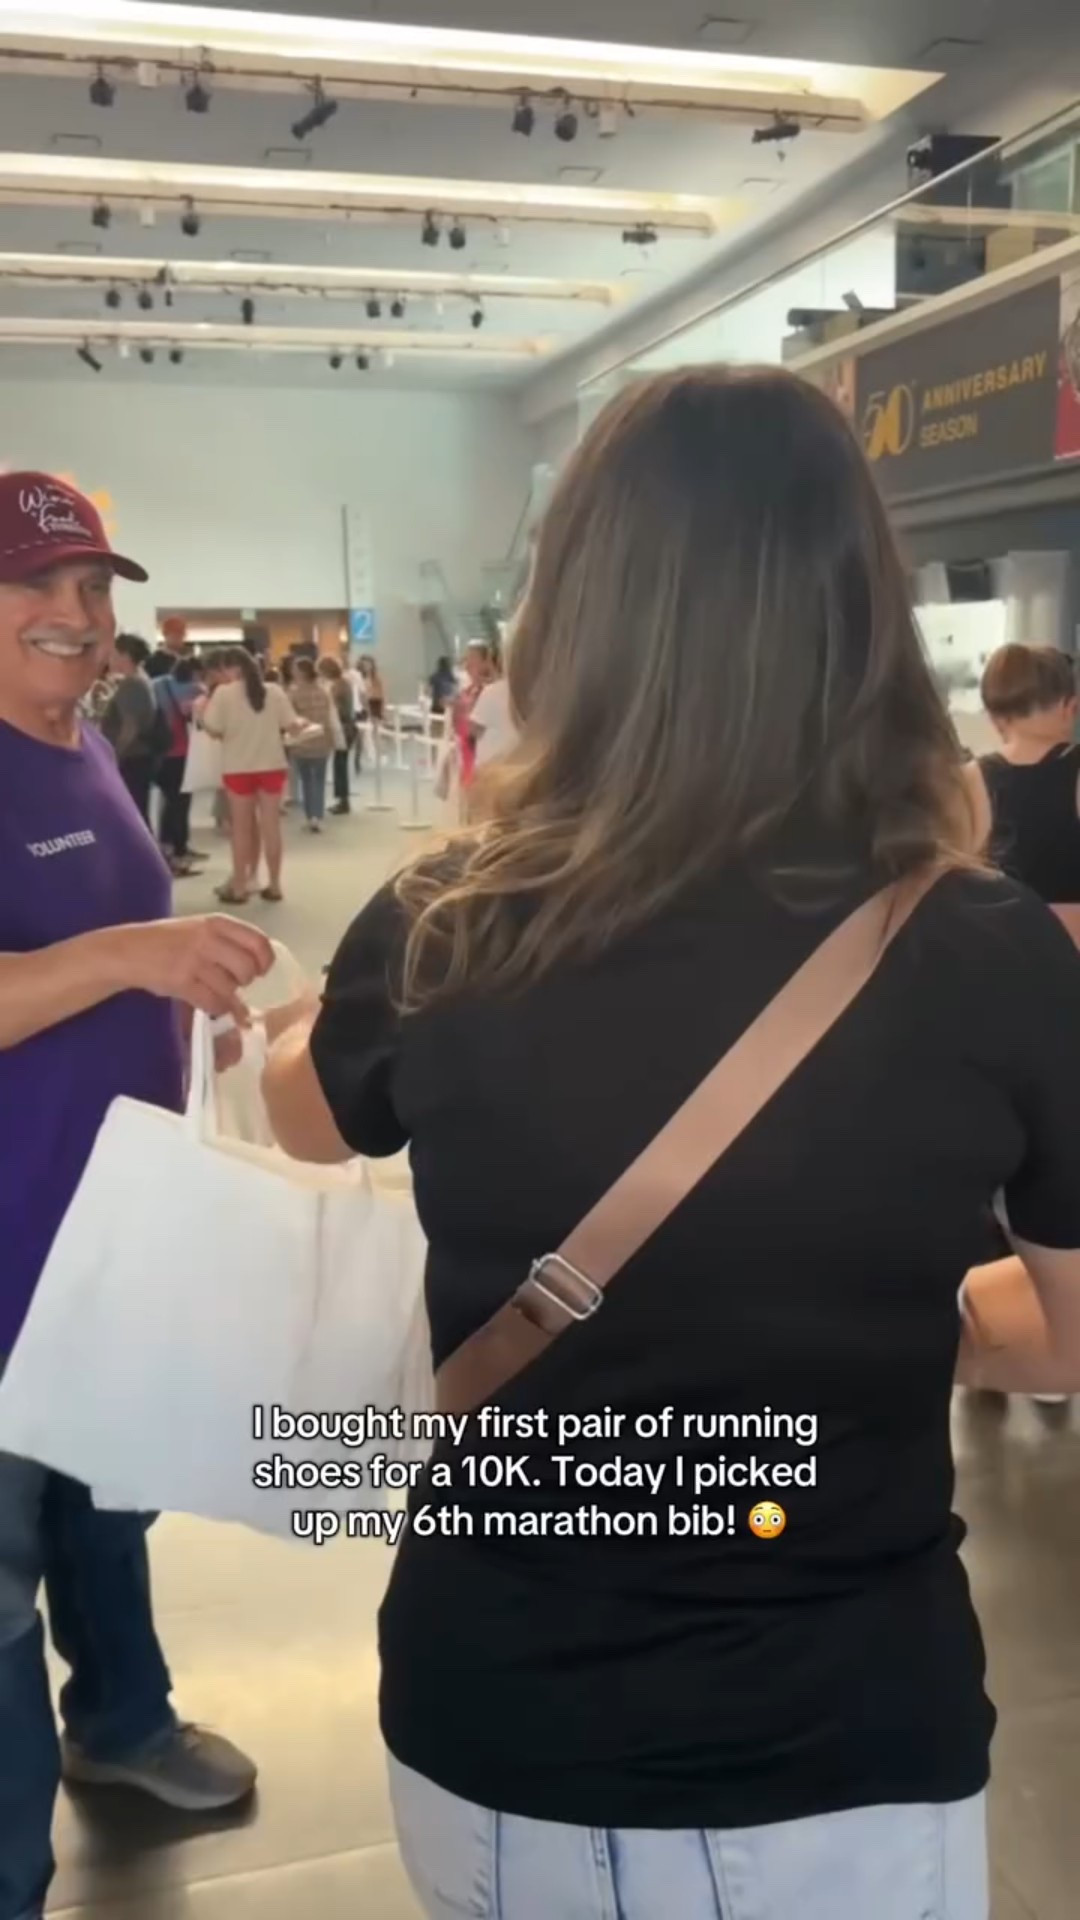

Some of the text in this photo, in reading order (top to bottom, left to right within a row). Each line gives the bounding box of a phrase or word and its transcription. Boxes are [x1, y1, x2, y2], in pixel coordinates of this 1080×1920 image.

[922, 351, 1048, 412] ANNIVERSARY
[919, 413, 978, 447] SEASON
[354, 610, 373, 641] 2
